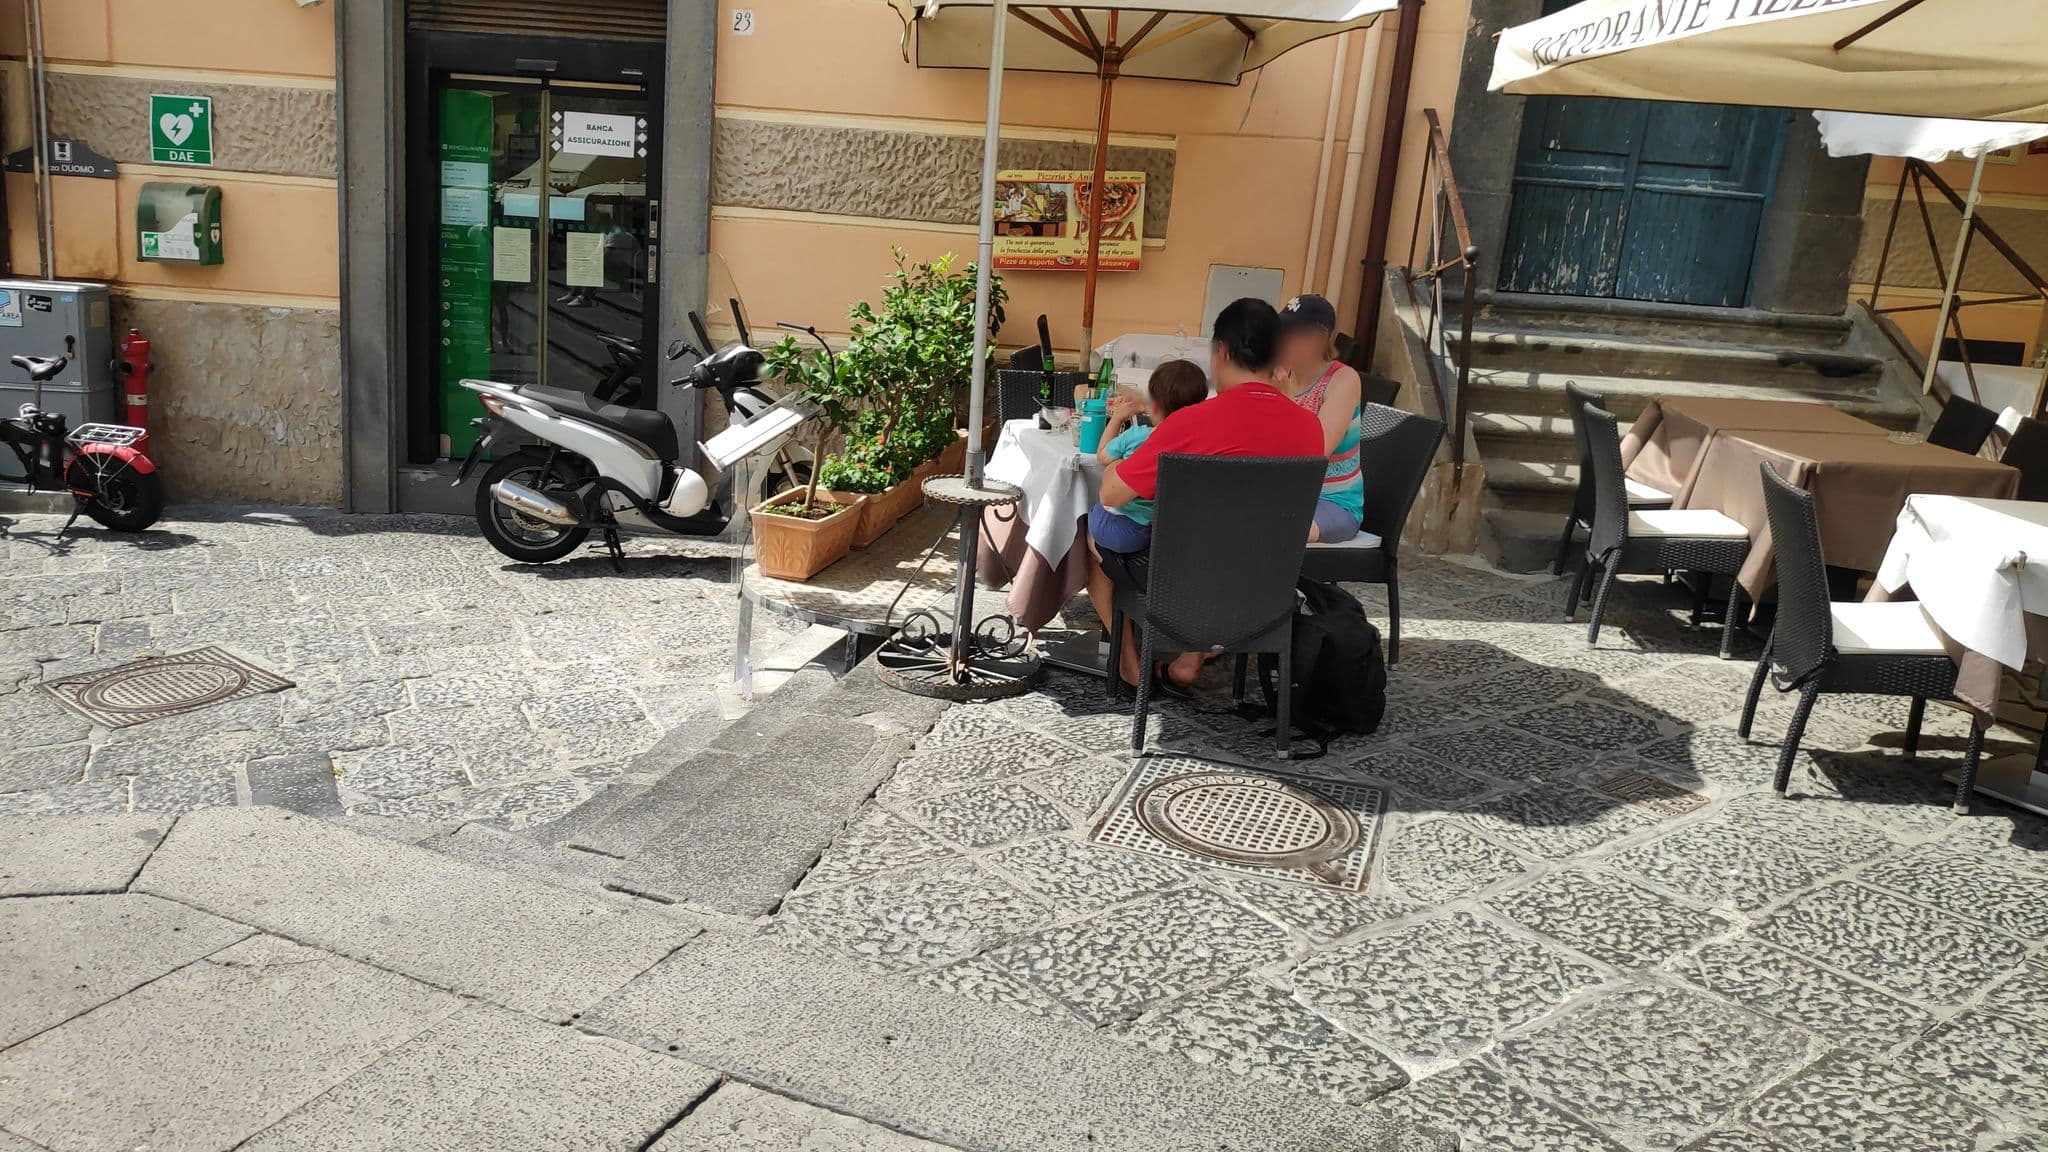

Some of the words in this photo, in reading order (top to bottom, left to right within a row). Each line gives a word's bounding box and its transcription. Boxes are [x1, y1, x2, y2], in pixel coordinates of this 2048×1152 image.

[733, 12, 751, 31] 23
[586, 124, 613, 132] BANCA
[567, 136, 631, 147] ASSICURAZIONE
[169, 150, 194, 162] DAE
[61, 164, 95, 174] DUOMO
[1037, 172, 1066, 181] Pizzeria
[1073, 220, 1137, 241] PZZA
[1028, 259, 1055, 267] asporto
